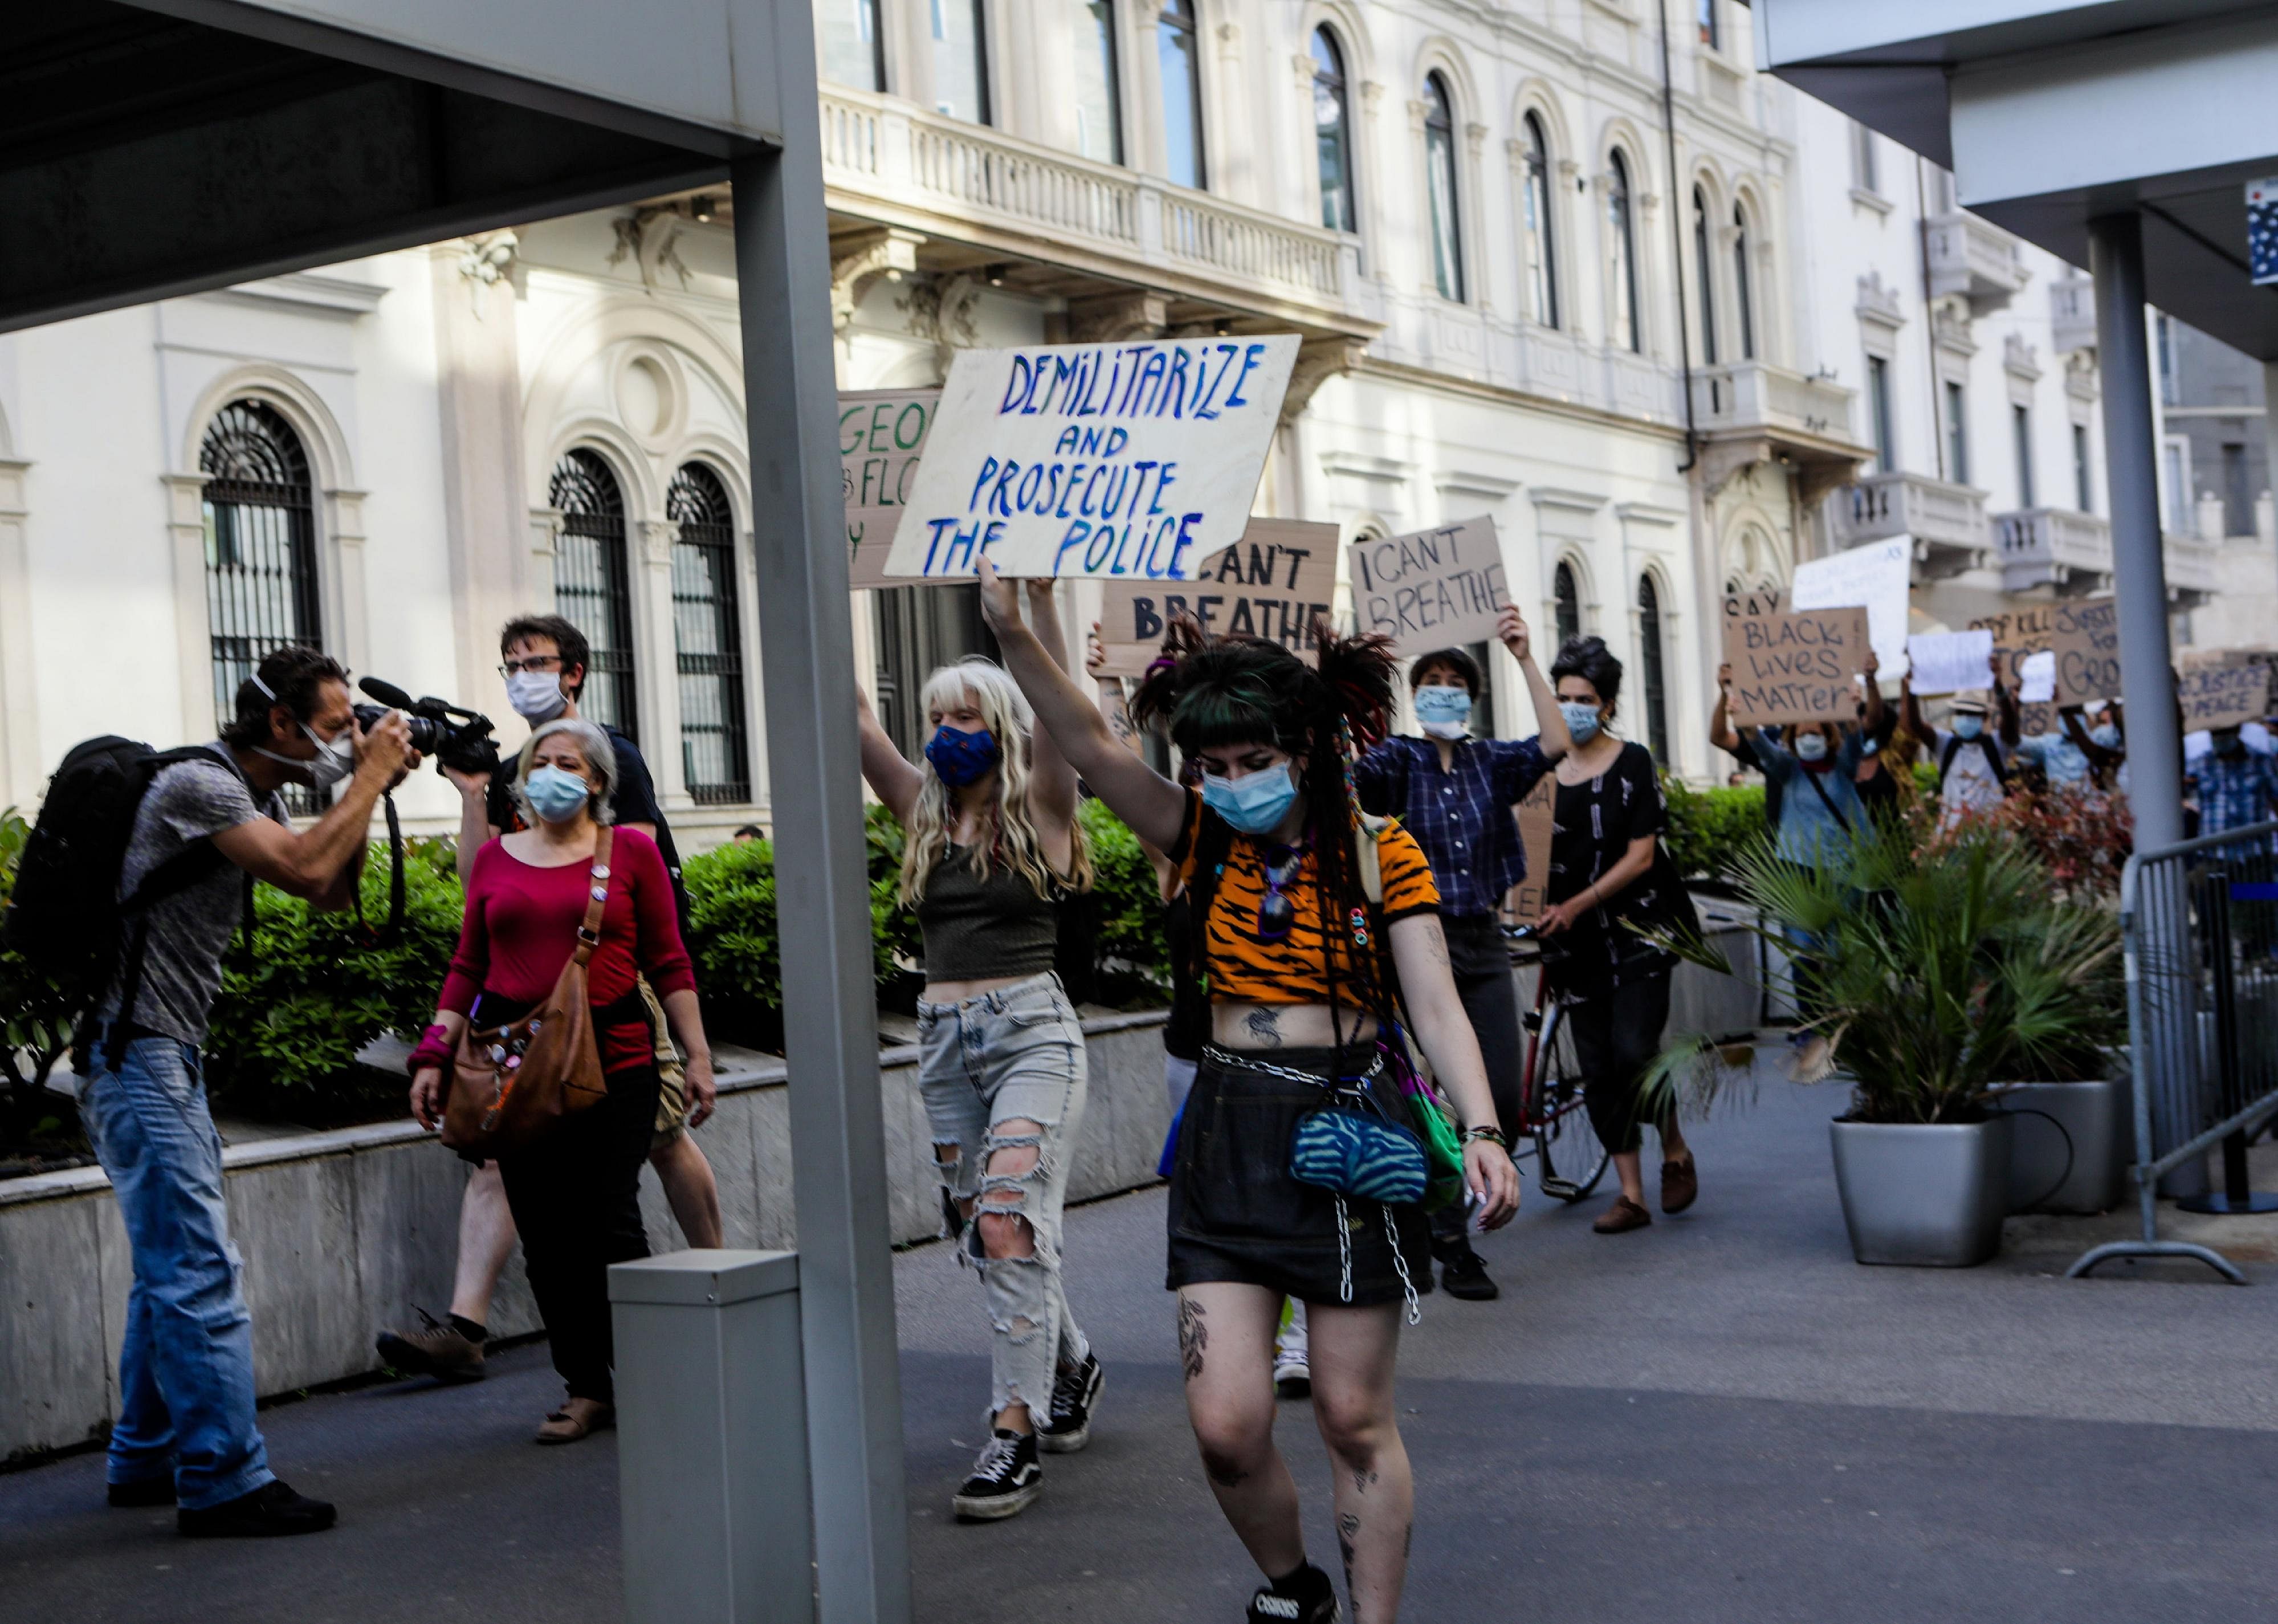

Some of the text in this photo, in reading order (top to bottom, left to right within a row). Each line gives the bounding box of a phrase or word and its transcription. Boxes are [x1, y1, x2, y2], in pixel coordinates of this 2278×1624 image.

[839, 401, 939, 455] GEO
[1055, 425, 1129, 457] AND
[969, 456, 1178, 520] PROSECUTE
[923, 518, 1008, 577] THE
[1199, 543, 1310, 590] AN'T
[1360, 550, 1373, 592] I
[1368, 562, 1506, 639] BREATHE
[1743, 619, 1844, 648] BLACK
